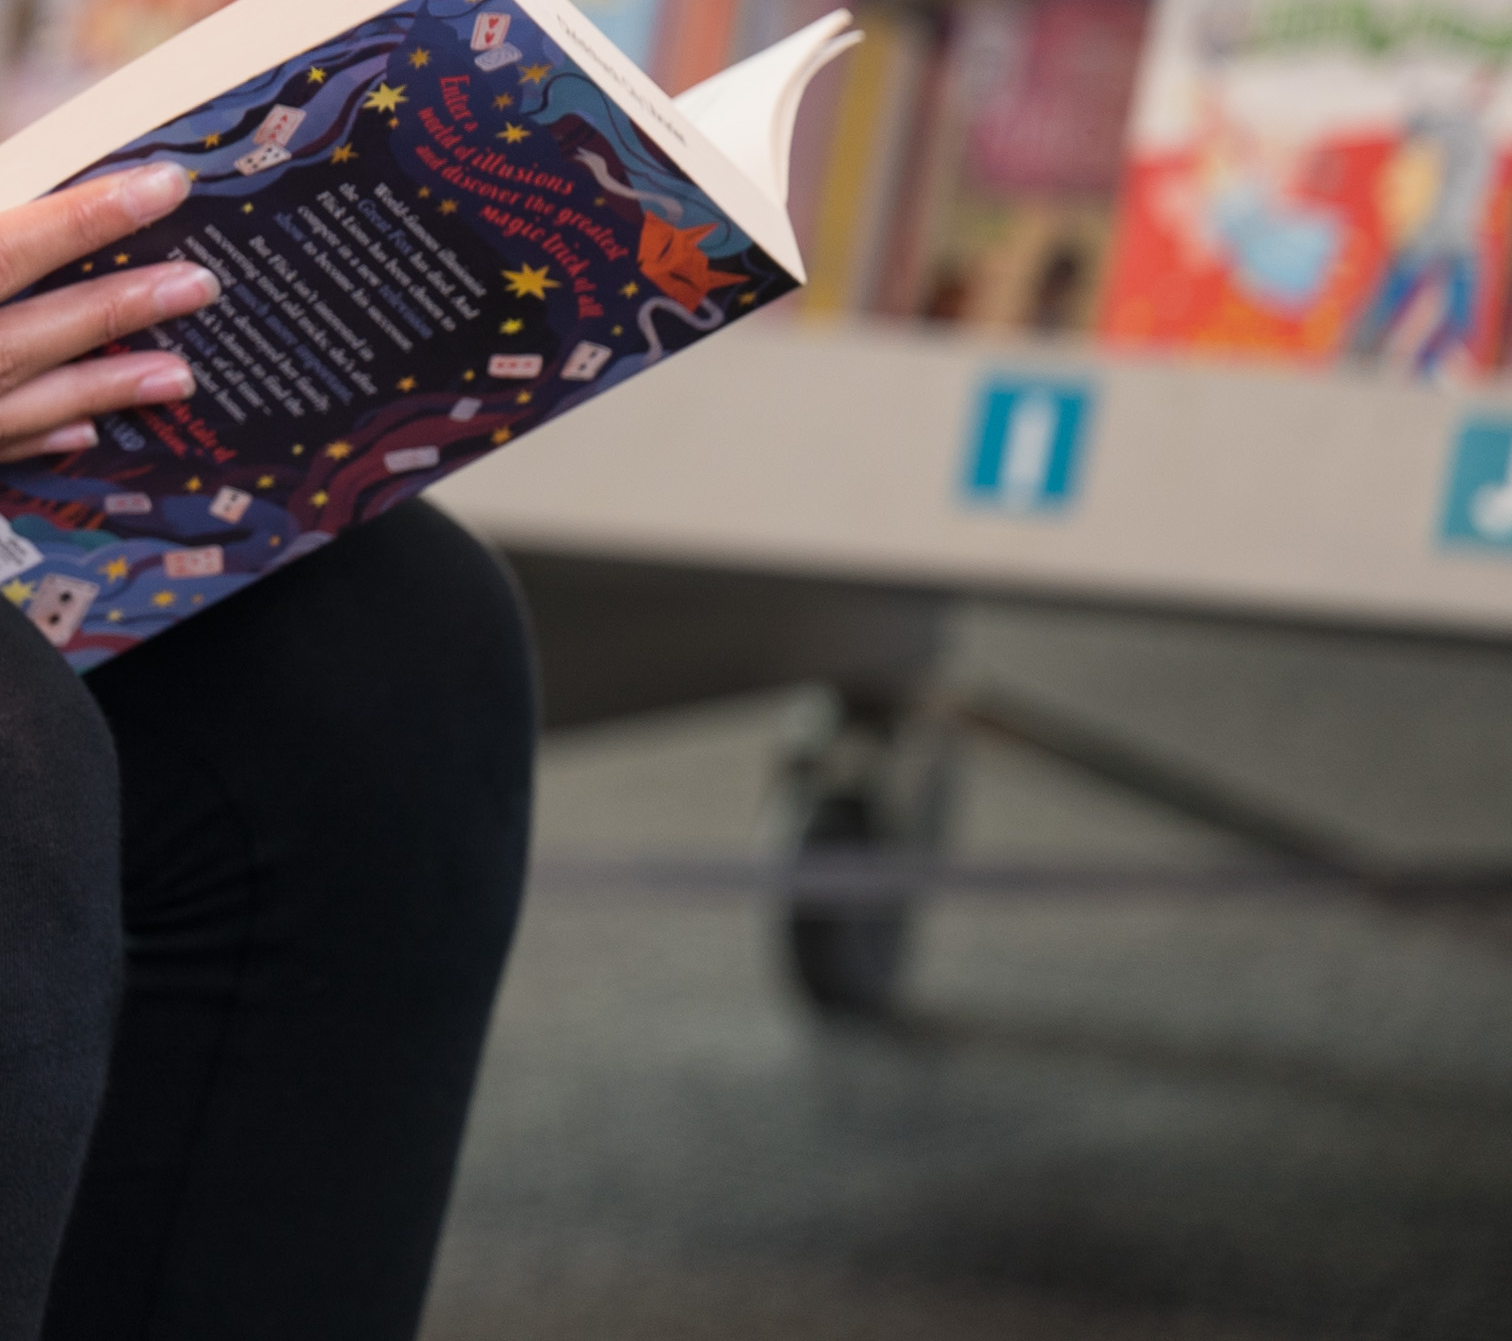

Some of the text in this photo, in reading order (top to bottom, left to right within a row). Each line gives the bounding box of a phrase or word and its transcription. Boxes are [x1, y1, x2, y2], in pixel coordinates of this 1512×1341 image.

[439, 74, 471, 120] Enter
[470, 149, 575, 195] illusions
[355, 197, 392, 234] Great
[440, 164, 521, 205] discover
[553, 207, 629, 261] greatest
[540, 232, 589, 278] trick
